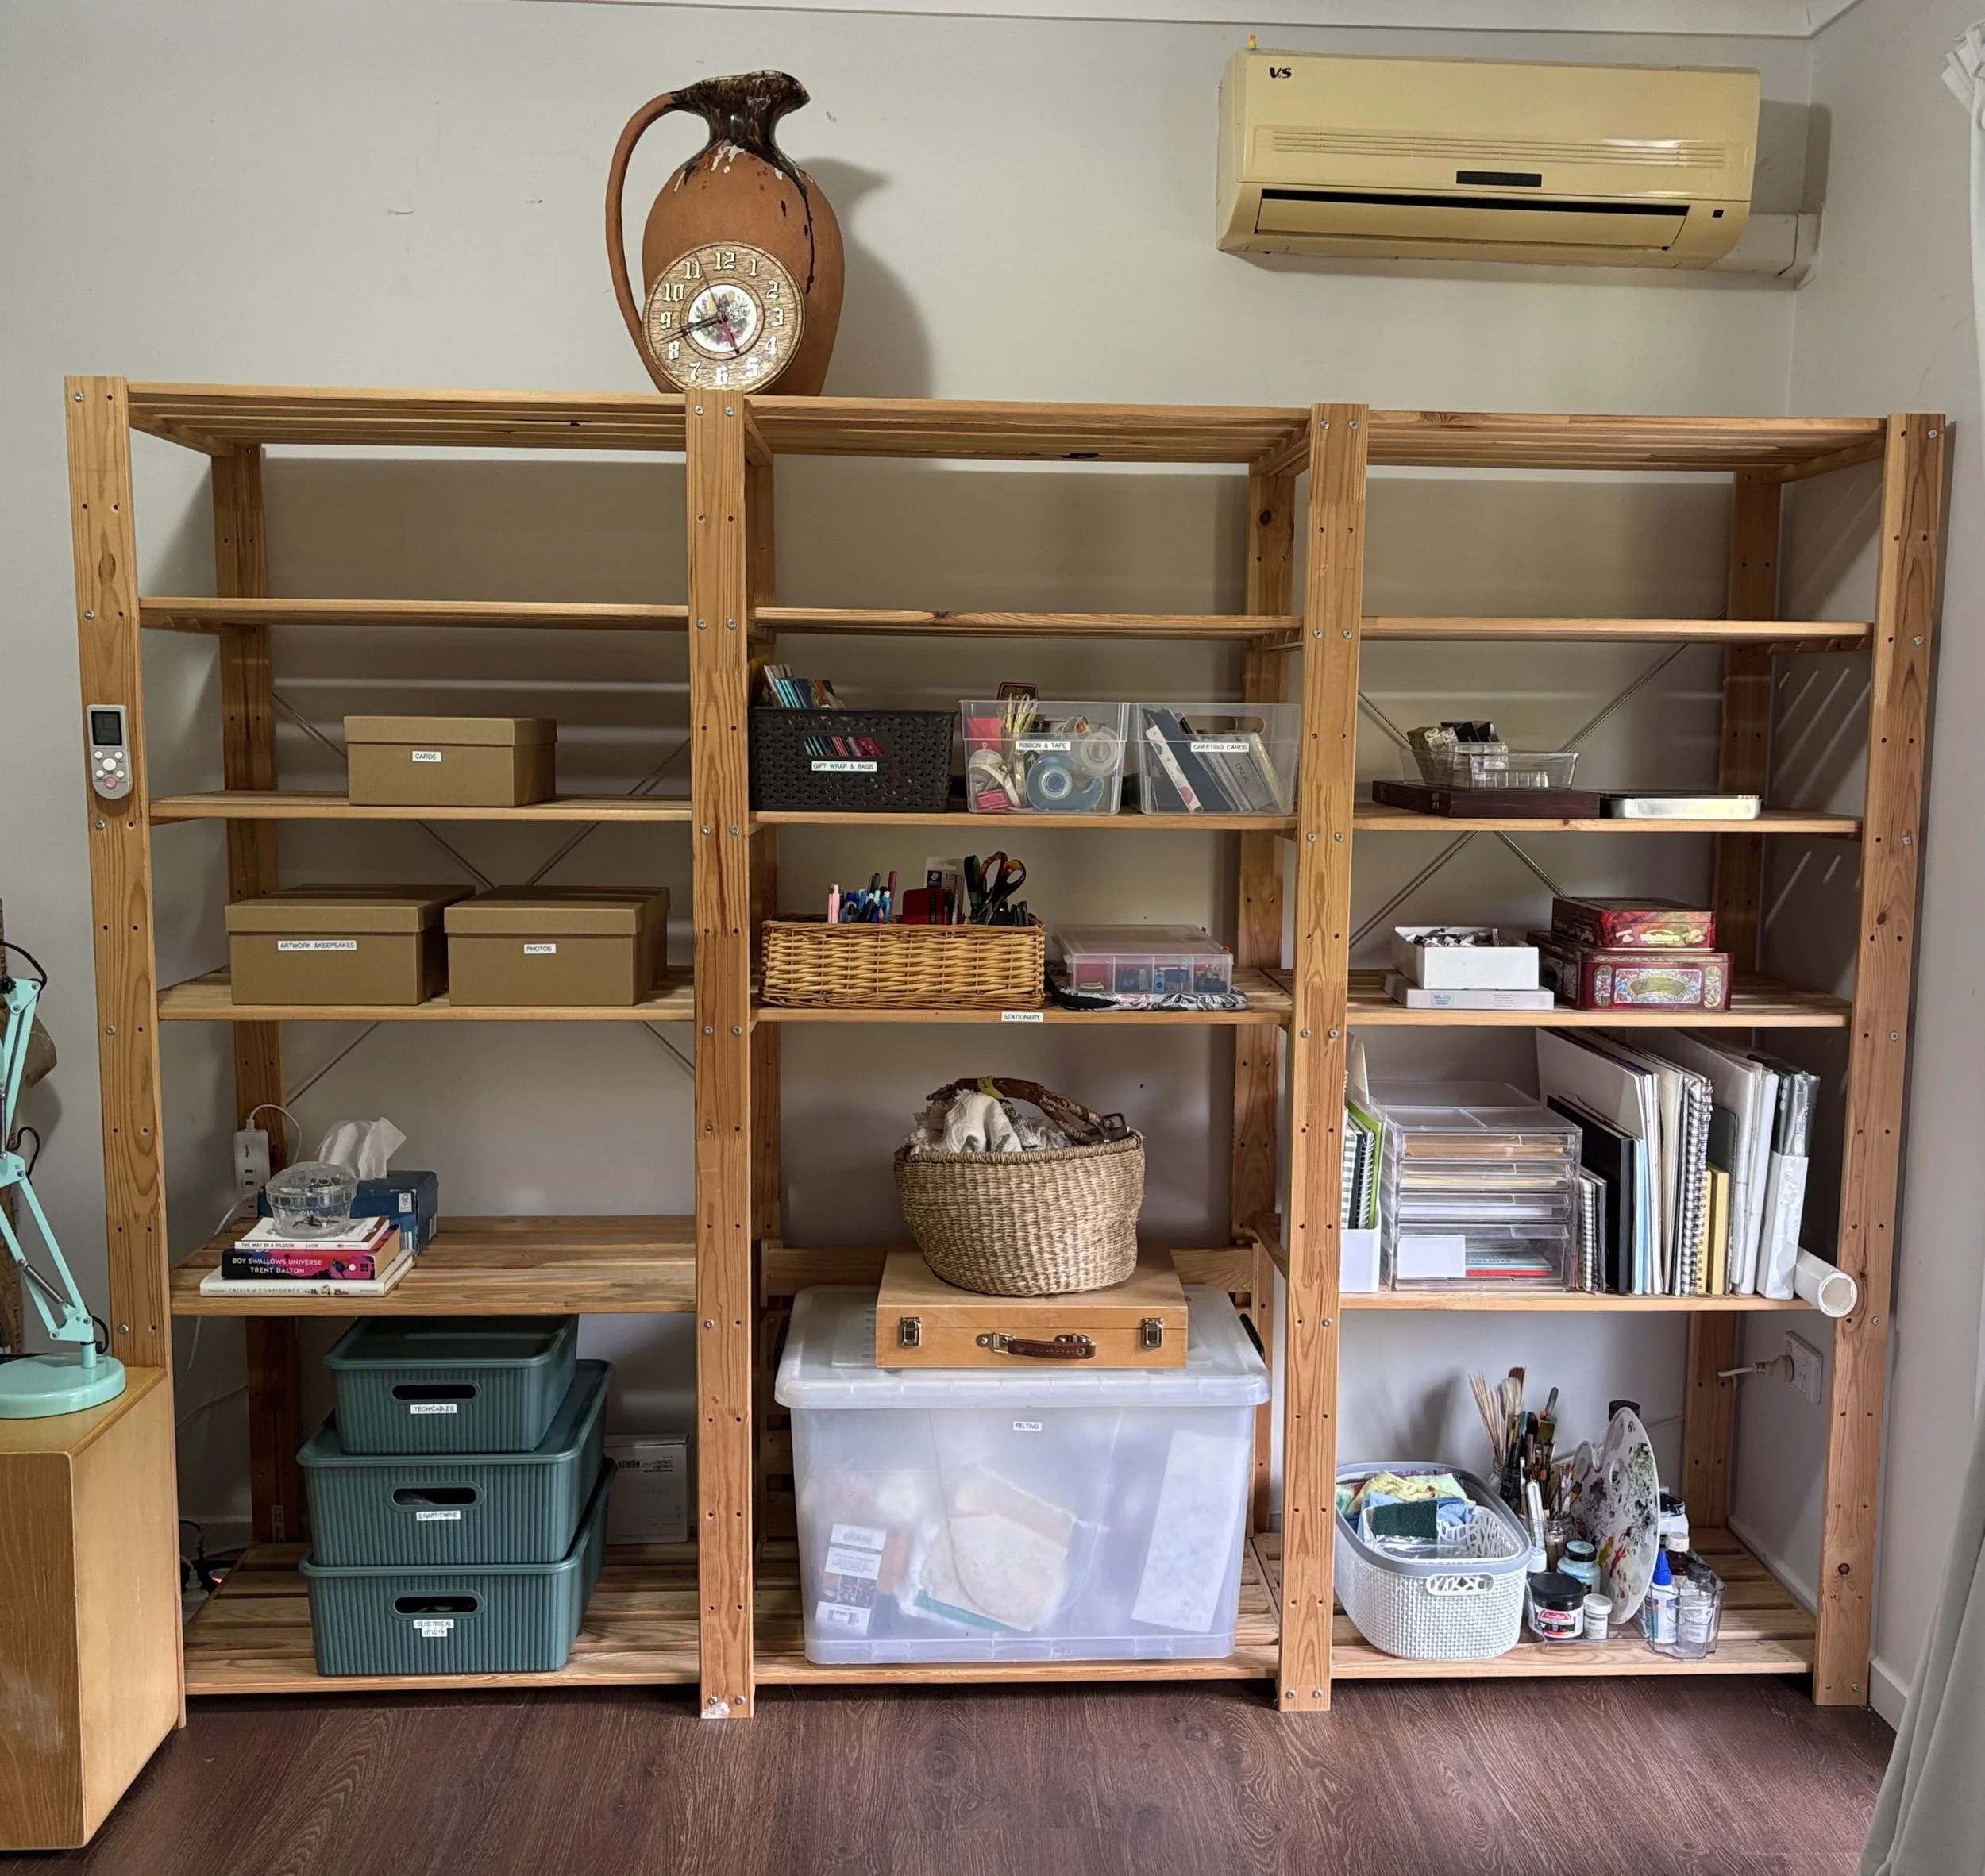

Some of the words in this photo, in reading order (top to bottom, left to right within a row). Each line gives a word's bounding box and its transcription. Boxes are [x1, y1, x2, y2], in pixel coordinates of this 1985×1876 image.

[683, 260, 702, 280] 11
[714, 252, 736, 271] 12
[749, 259, 757, 277] 1
[663, 283, 686, 302] 10
[766, 281, 780, 299] 2
[660, 311, 673, 329] 9
[771, 307, 784, 326] 3
[668, 341, 680, 360] 8
[764, 336, 778, 355] 4
[688, 361, 701, 382] 7
[715, 365, 730, 385] 6
[745, 357, 759, 377] 5
